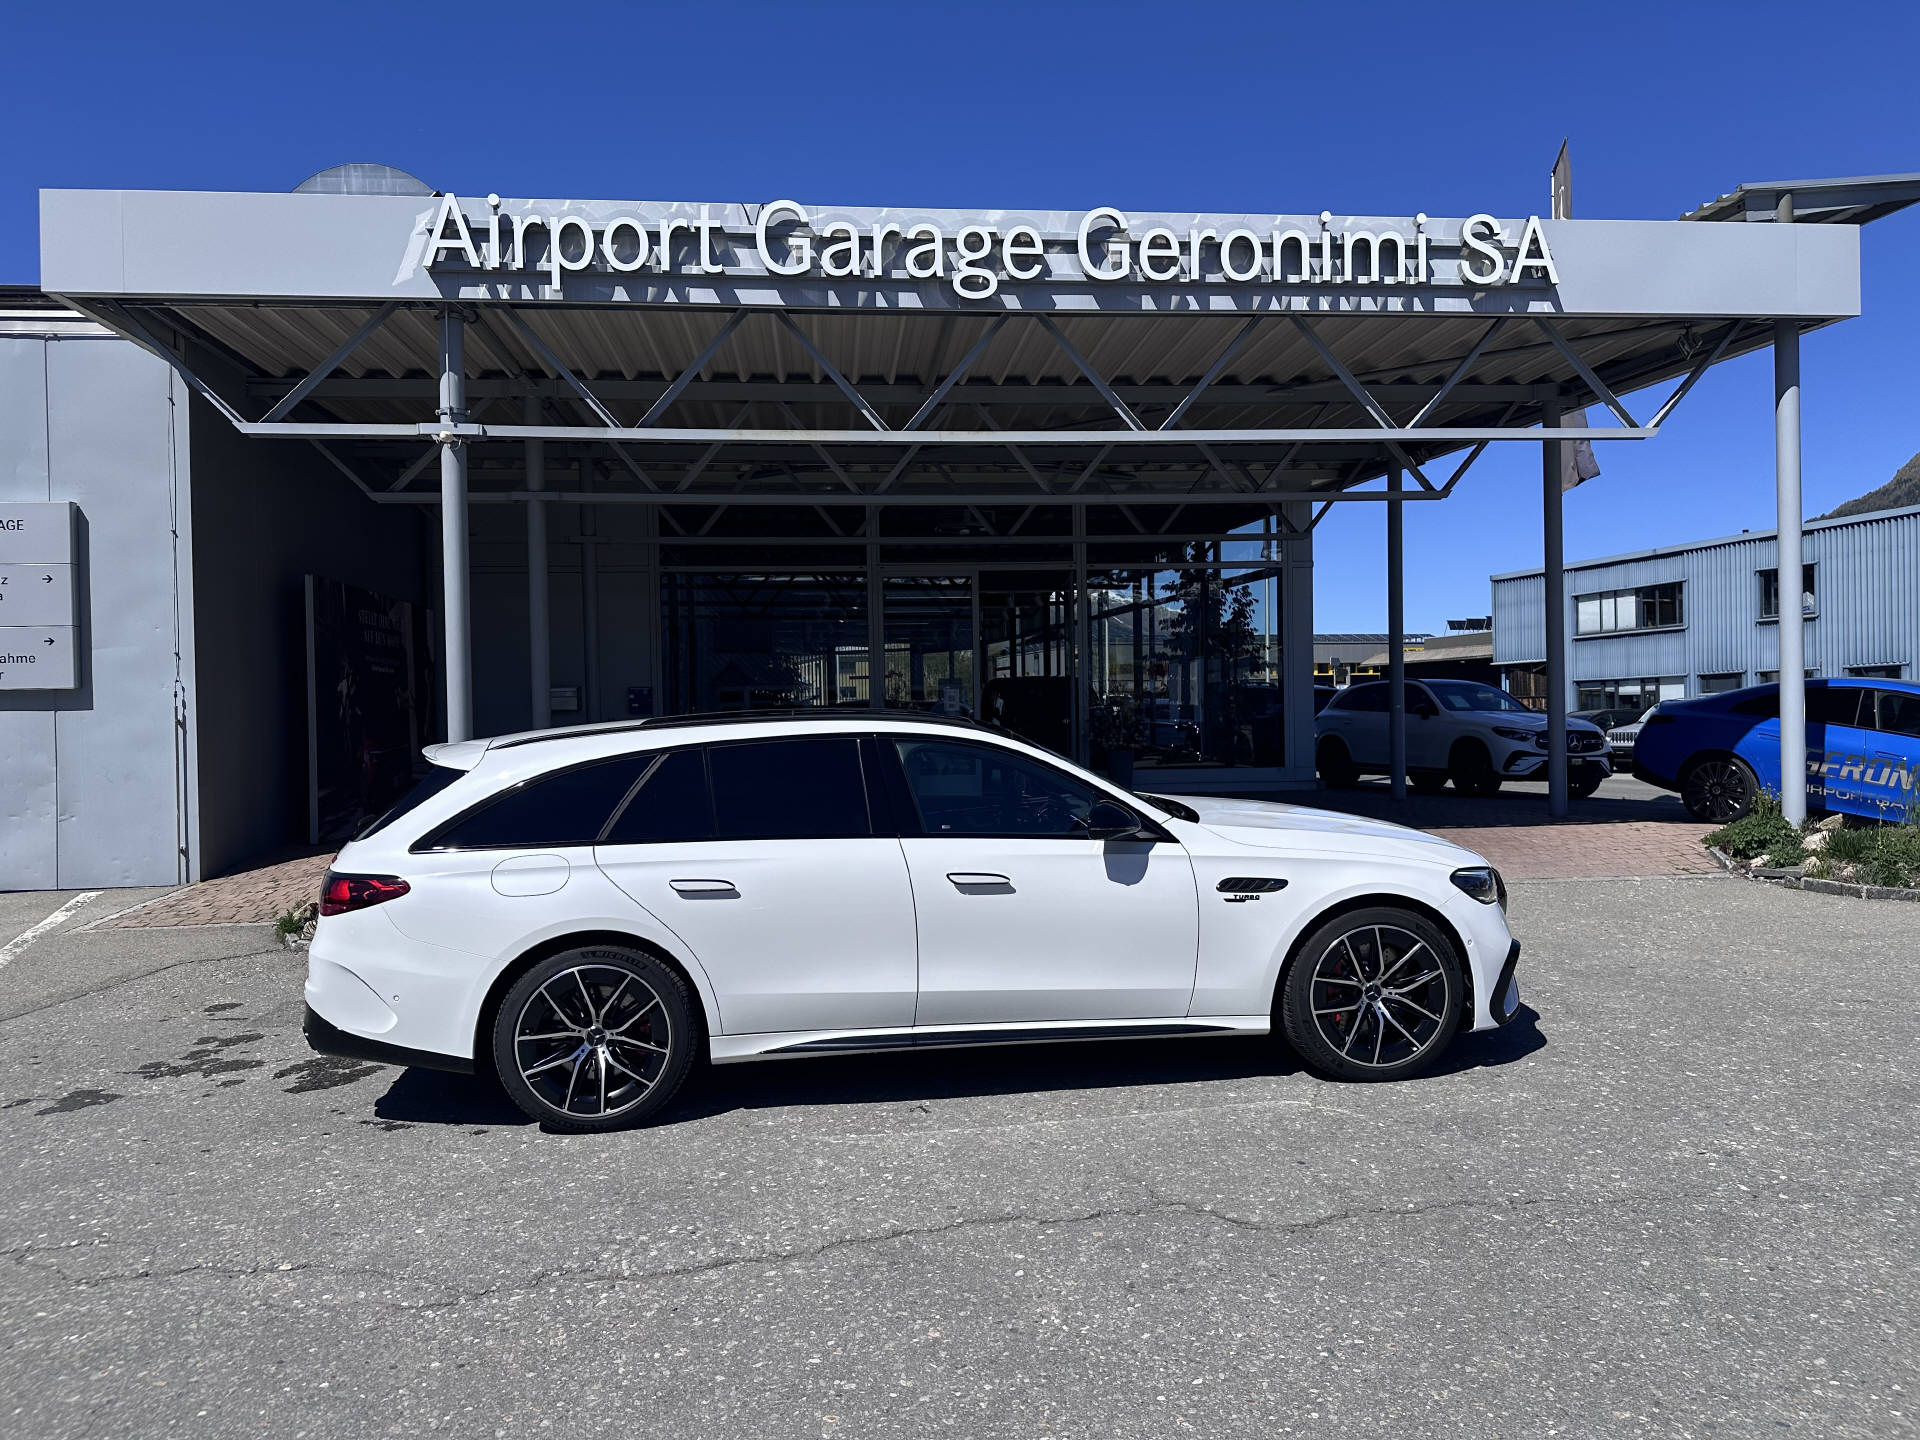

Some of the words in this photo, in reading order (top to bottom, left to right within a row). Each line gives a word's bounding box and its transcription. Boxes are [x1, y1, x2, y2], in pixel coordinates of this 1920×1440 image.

[422, 192, 724, 291] Airport
[755, 199, 1044, 299] Garage
[1077, 206, 1428, 284] Geronimi
[1462, 213, 1560, 286] SA
